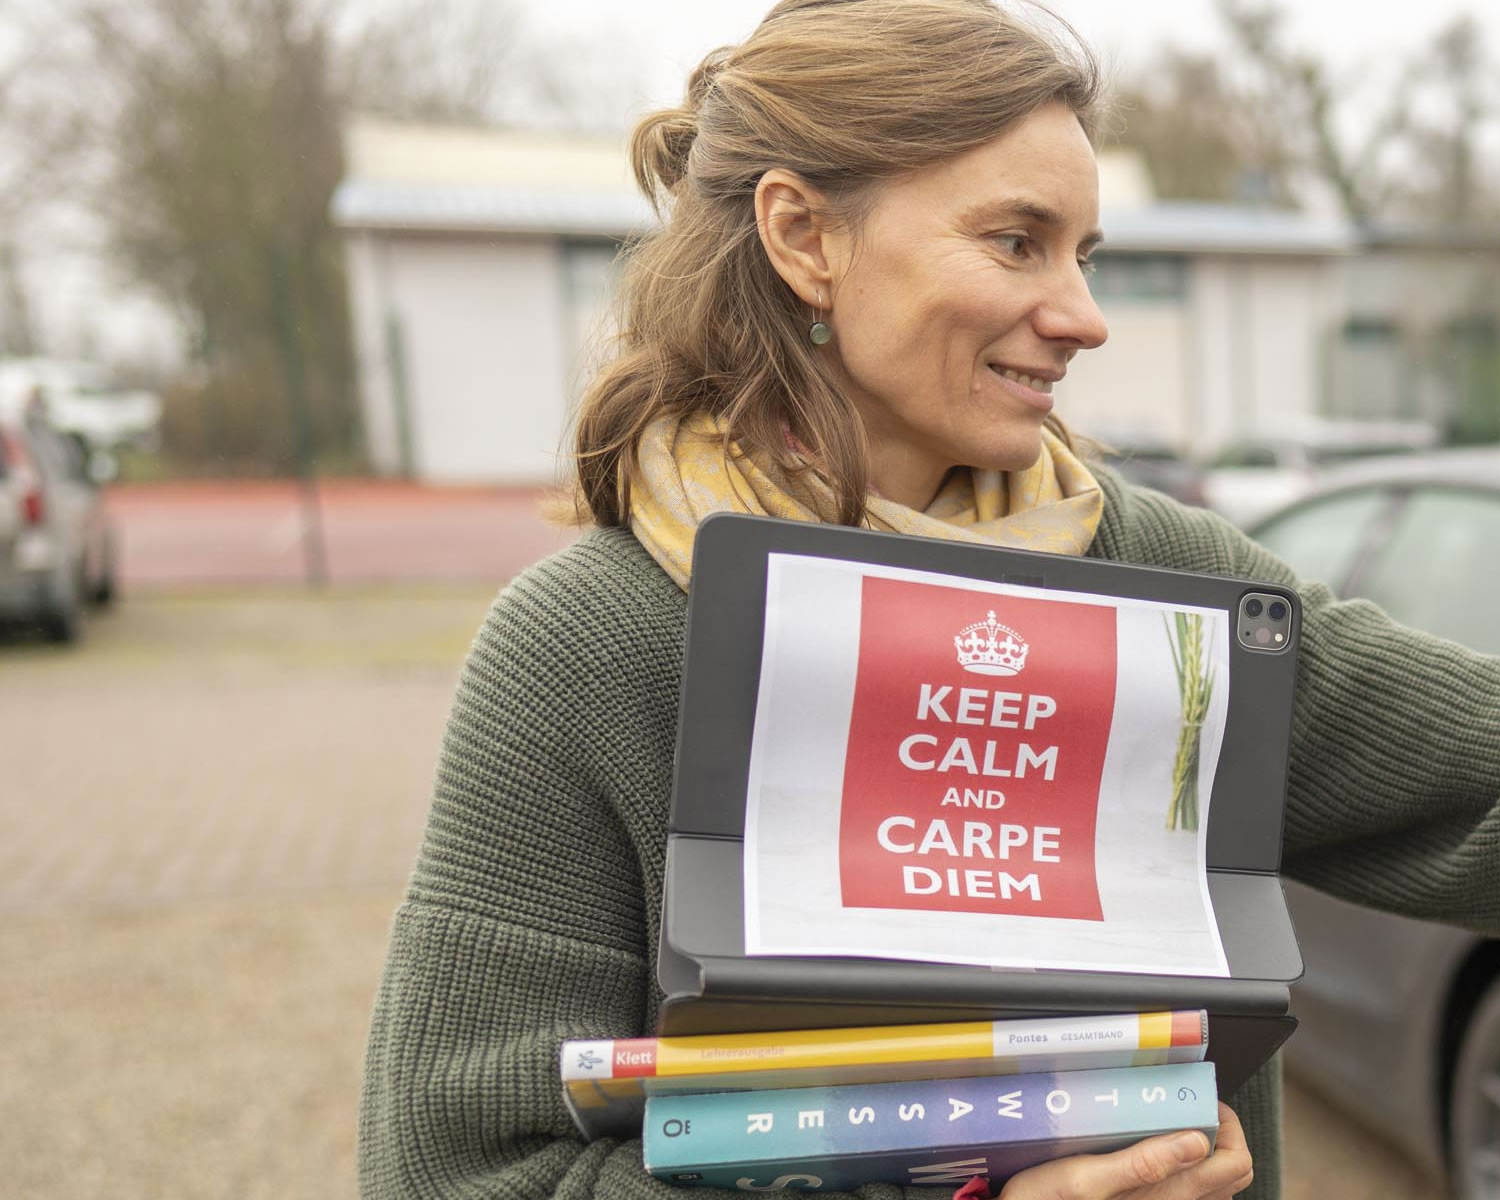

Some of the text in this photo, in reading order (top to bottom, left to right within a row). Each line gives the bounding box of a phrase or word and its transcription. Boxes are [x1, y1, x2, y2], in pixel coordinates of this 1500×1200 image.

[916, 683, 1057, 730] KEEP
[898, 733, 1059, 781] CALM
[940, 787, 1006, 810] AND
[877, 816, 1061, 863] CARPE
[903, 866, 1042, 901] DIEM
[1008, 1030, 1124, 1044] Pontes GESAMTBAND
[615, 1051, 653, 1066] Klett
[746, 1086, 1167, 1135] STOWASSER
